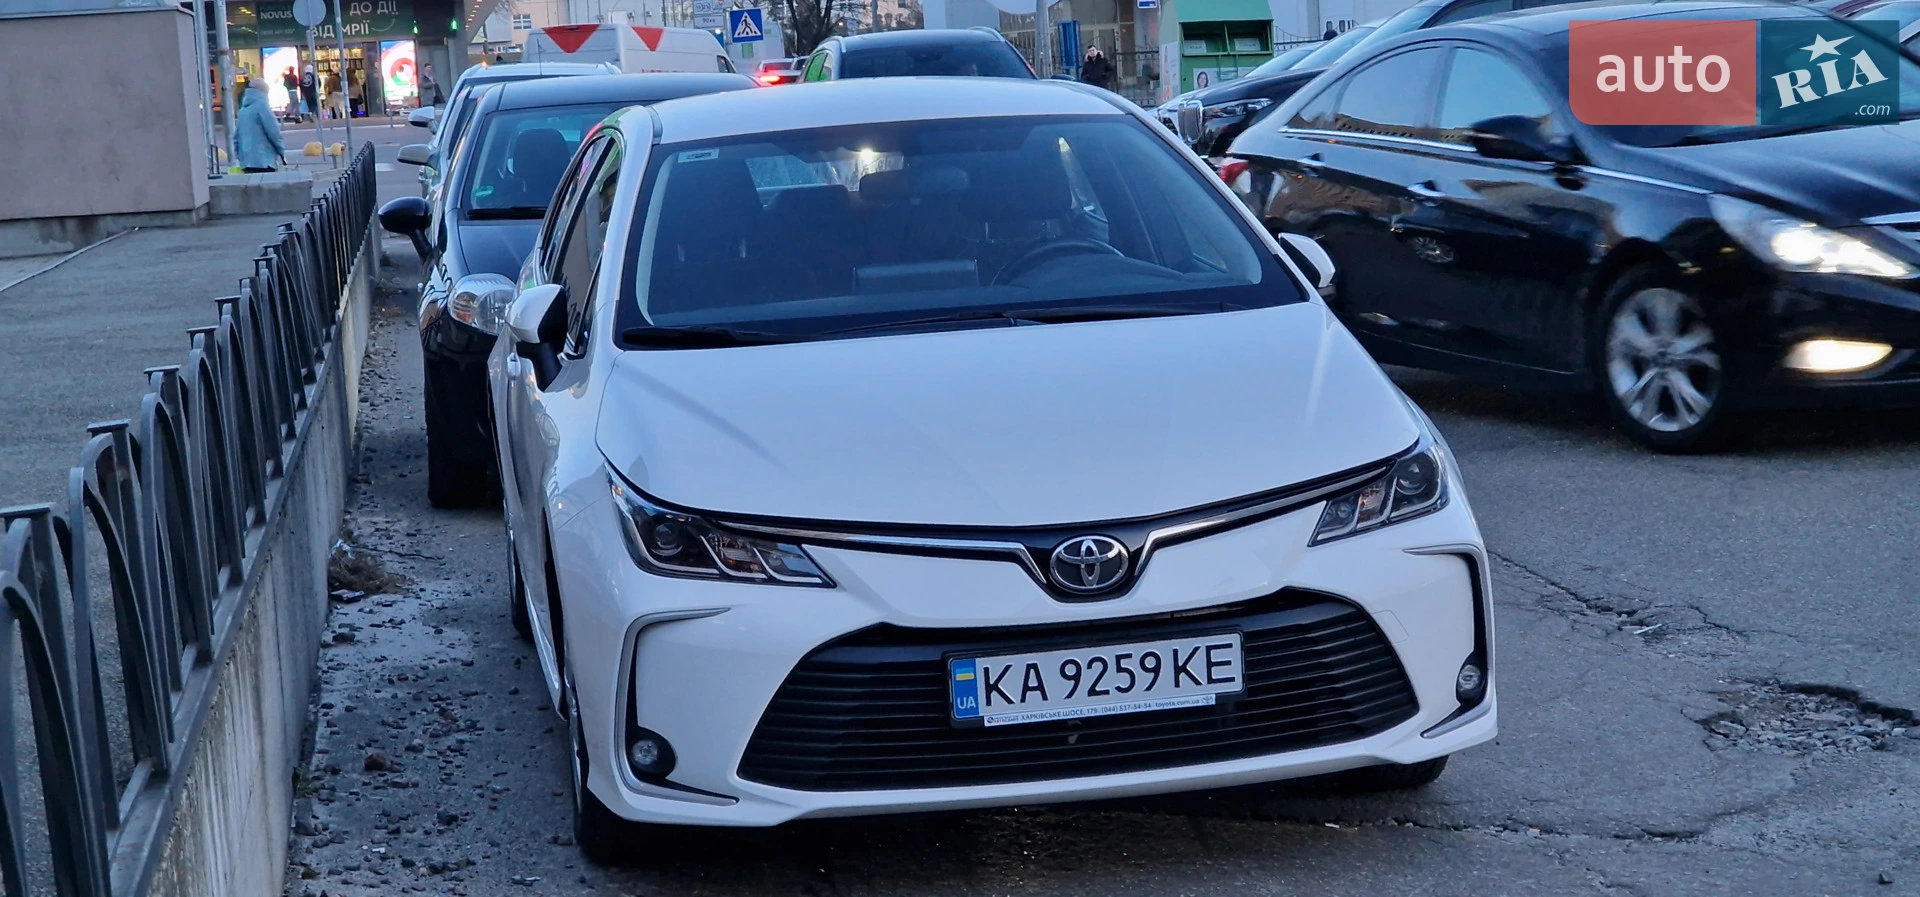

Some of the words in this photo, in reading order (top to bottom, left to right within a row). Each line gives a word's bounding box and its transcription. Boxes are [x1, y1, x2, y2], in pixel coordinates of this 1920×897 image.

[260, 10, 292, 19] NOVUS
[350, 2, 372, 16] ДО
[983, 661, 1049, 706] KA
[1059, 651, 1162, 700] 9259
[1172, 642, 1237, 689] KE
[957, 695, 977, 710] UA
[1021, 710, 1061, 721] ХАРКІВСЬКЕ
[1087, 707, 1098, 715] 179
[1101, 704, 1119, 714] (044)
[1119, 703, 1152, 712] 537-54-54
[1155, 698, 1200, 710] toyota.com.ua
